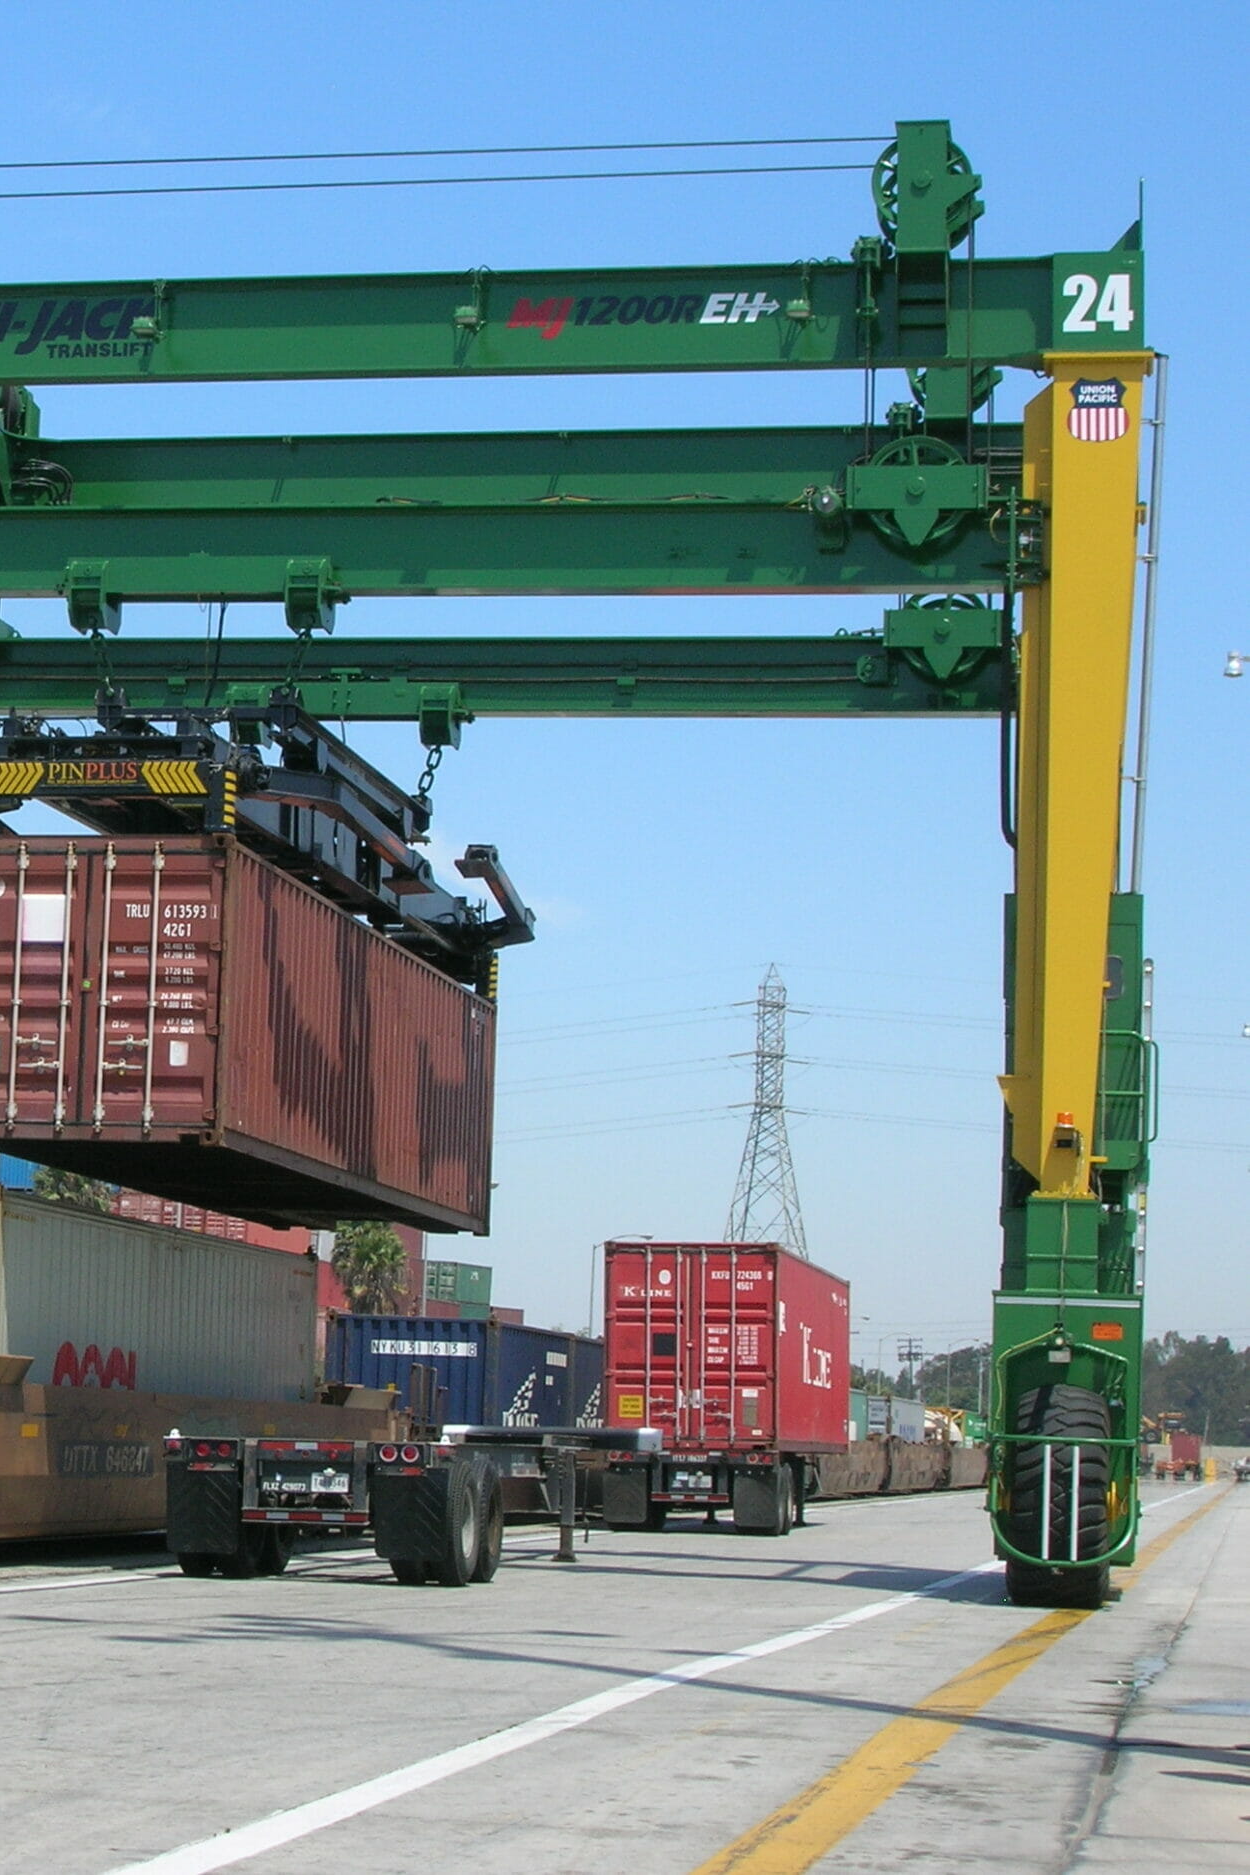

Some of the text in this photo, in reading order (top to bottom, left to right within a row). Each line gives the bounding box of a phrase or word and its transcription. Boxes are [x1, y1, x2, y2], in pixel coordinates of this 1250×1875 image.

[1062, 273, 1134, 333] 24
[46, 342, 154, 359] TRANSLIFT
[1079, 385, 1116, 394] UNION
[1077, 394, 1118, 403] PACIFIC
[49, 761, 138, 779] PINPLUS
[125, 904, 151, 918] TRLU
[163, 904, 207, 919] 613593
[163, 923, 192, 937] 42G1
